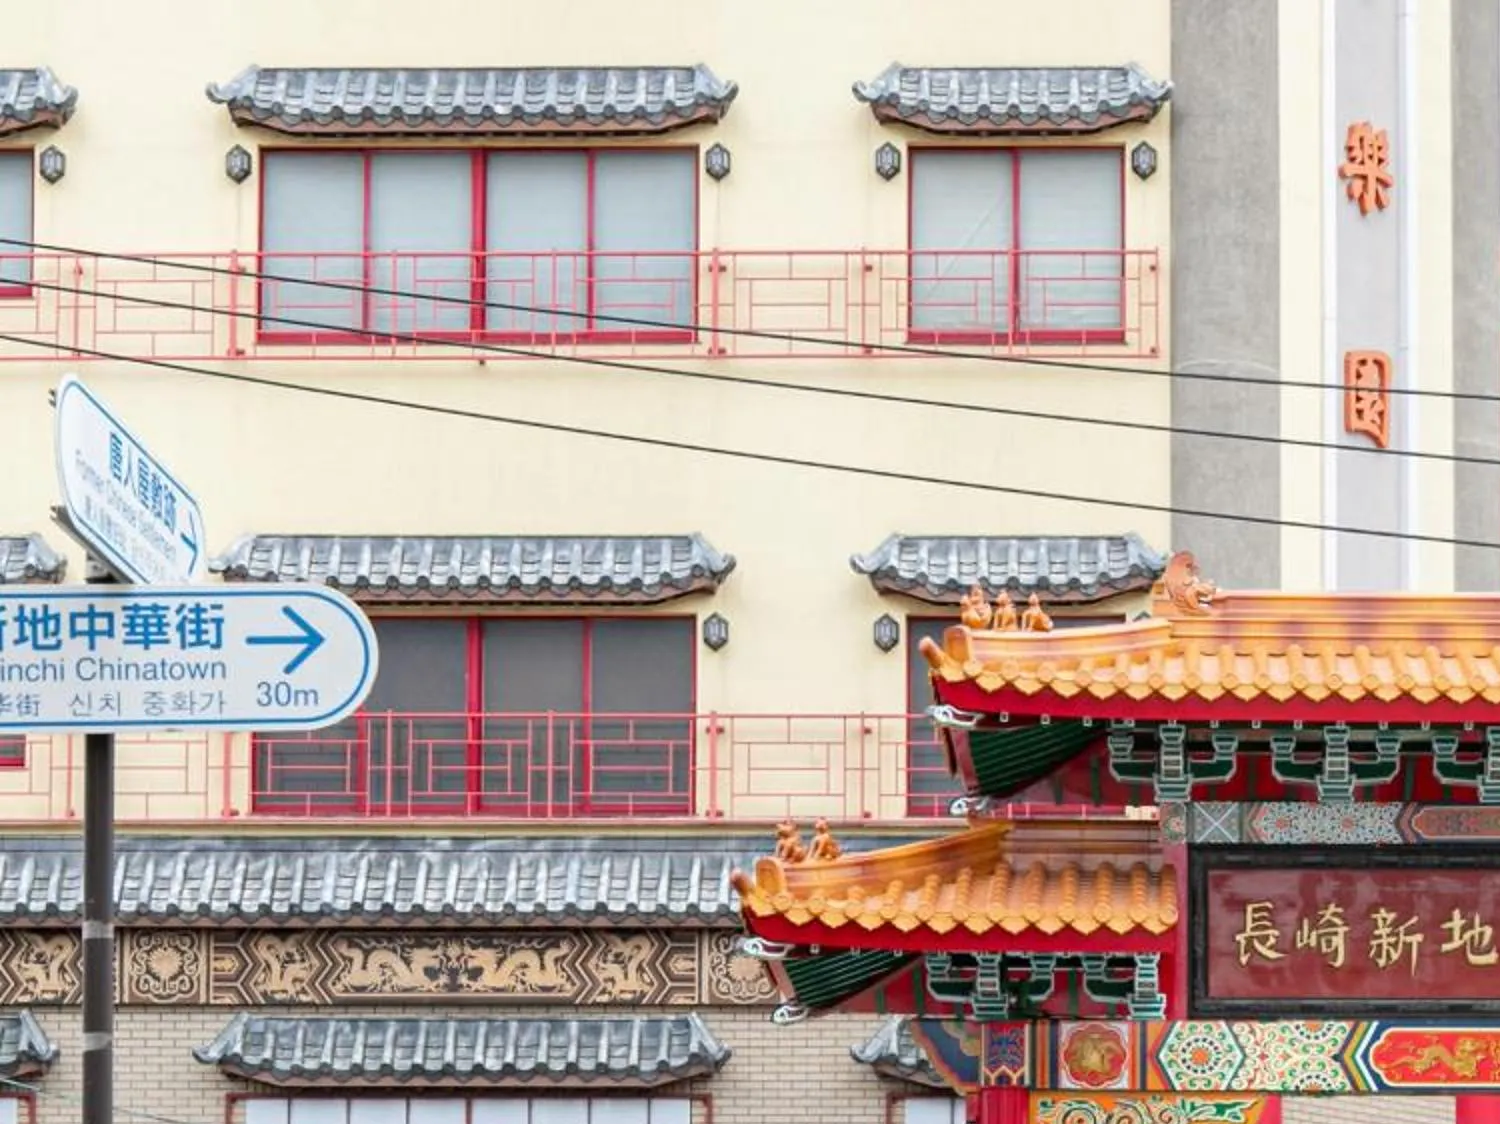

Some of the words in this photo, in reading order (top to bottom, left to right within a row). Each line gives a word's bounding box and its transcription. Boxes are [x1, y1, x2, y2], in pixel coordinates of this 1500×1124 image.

[76, 657, 226, 682] Chinatown
[69, 691, 121, 716] 신치
[143, 690, 226, 716] 중화가
[256, 682, 319, 707] 30m
